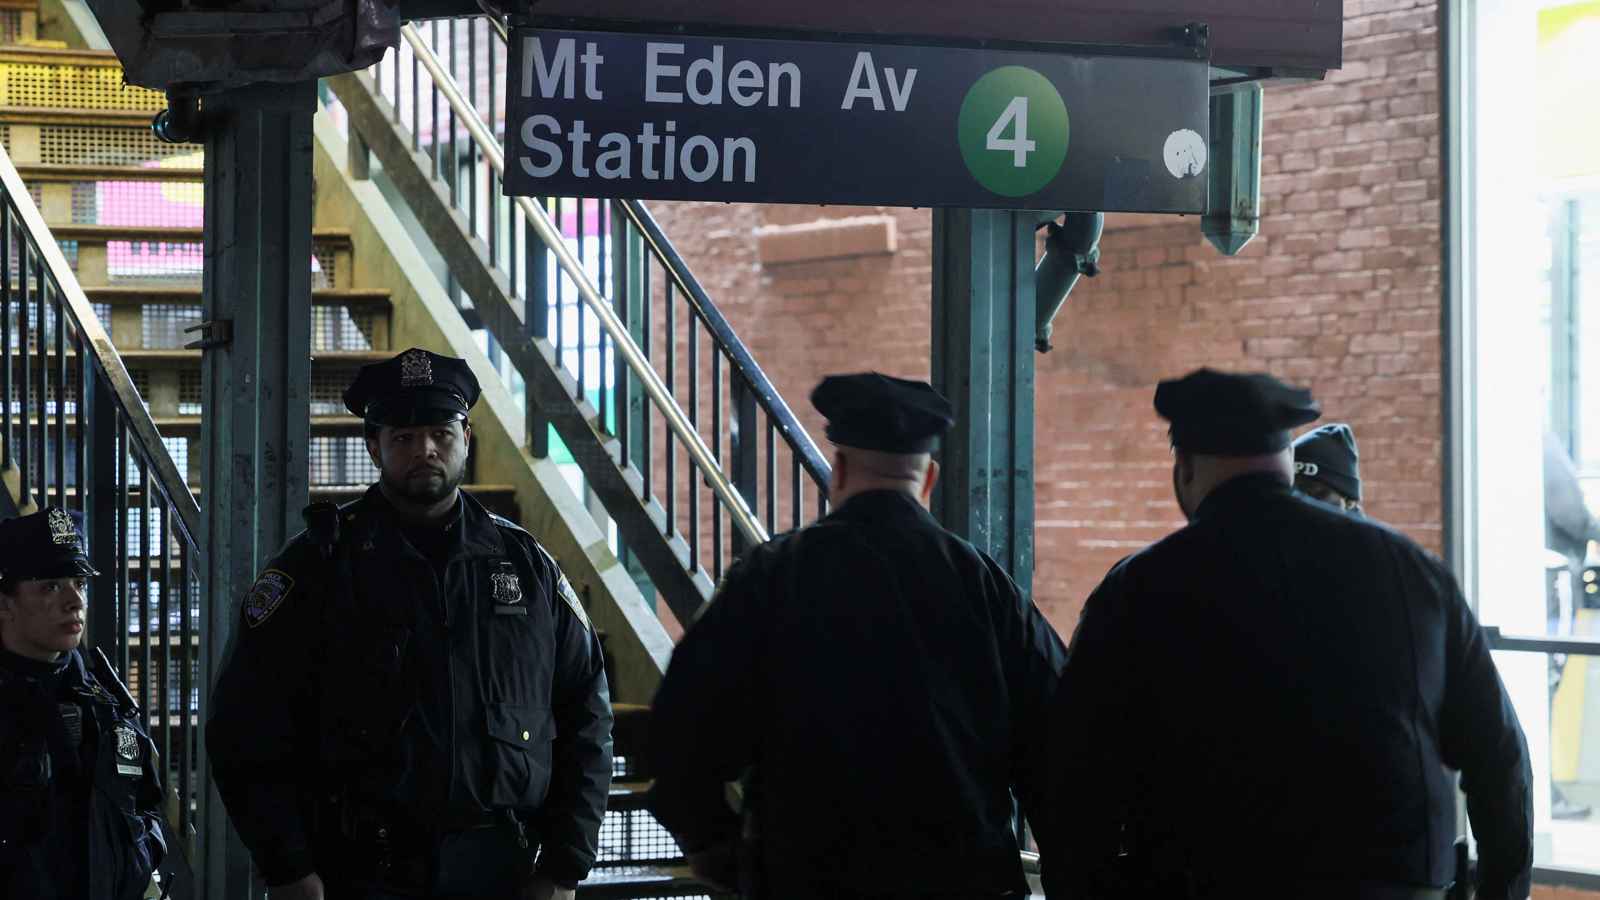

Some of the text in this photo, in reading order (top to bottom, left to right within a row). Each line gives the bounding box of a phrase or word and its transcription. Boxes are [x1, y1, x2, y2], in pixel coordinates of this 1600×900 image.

[521, 36, 918, 111] Mt Eden Av
[519, 114, 757, 183] Station
[986, 96, 1036, 167] 4
